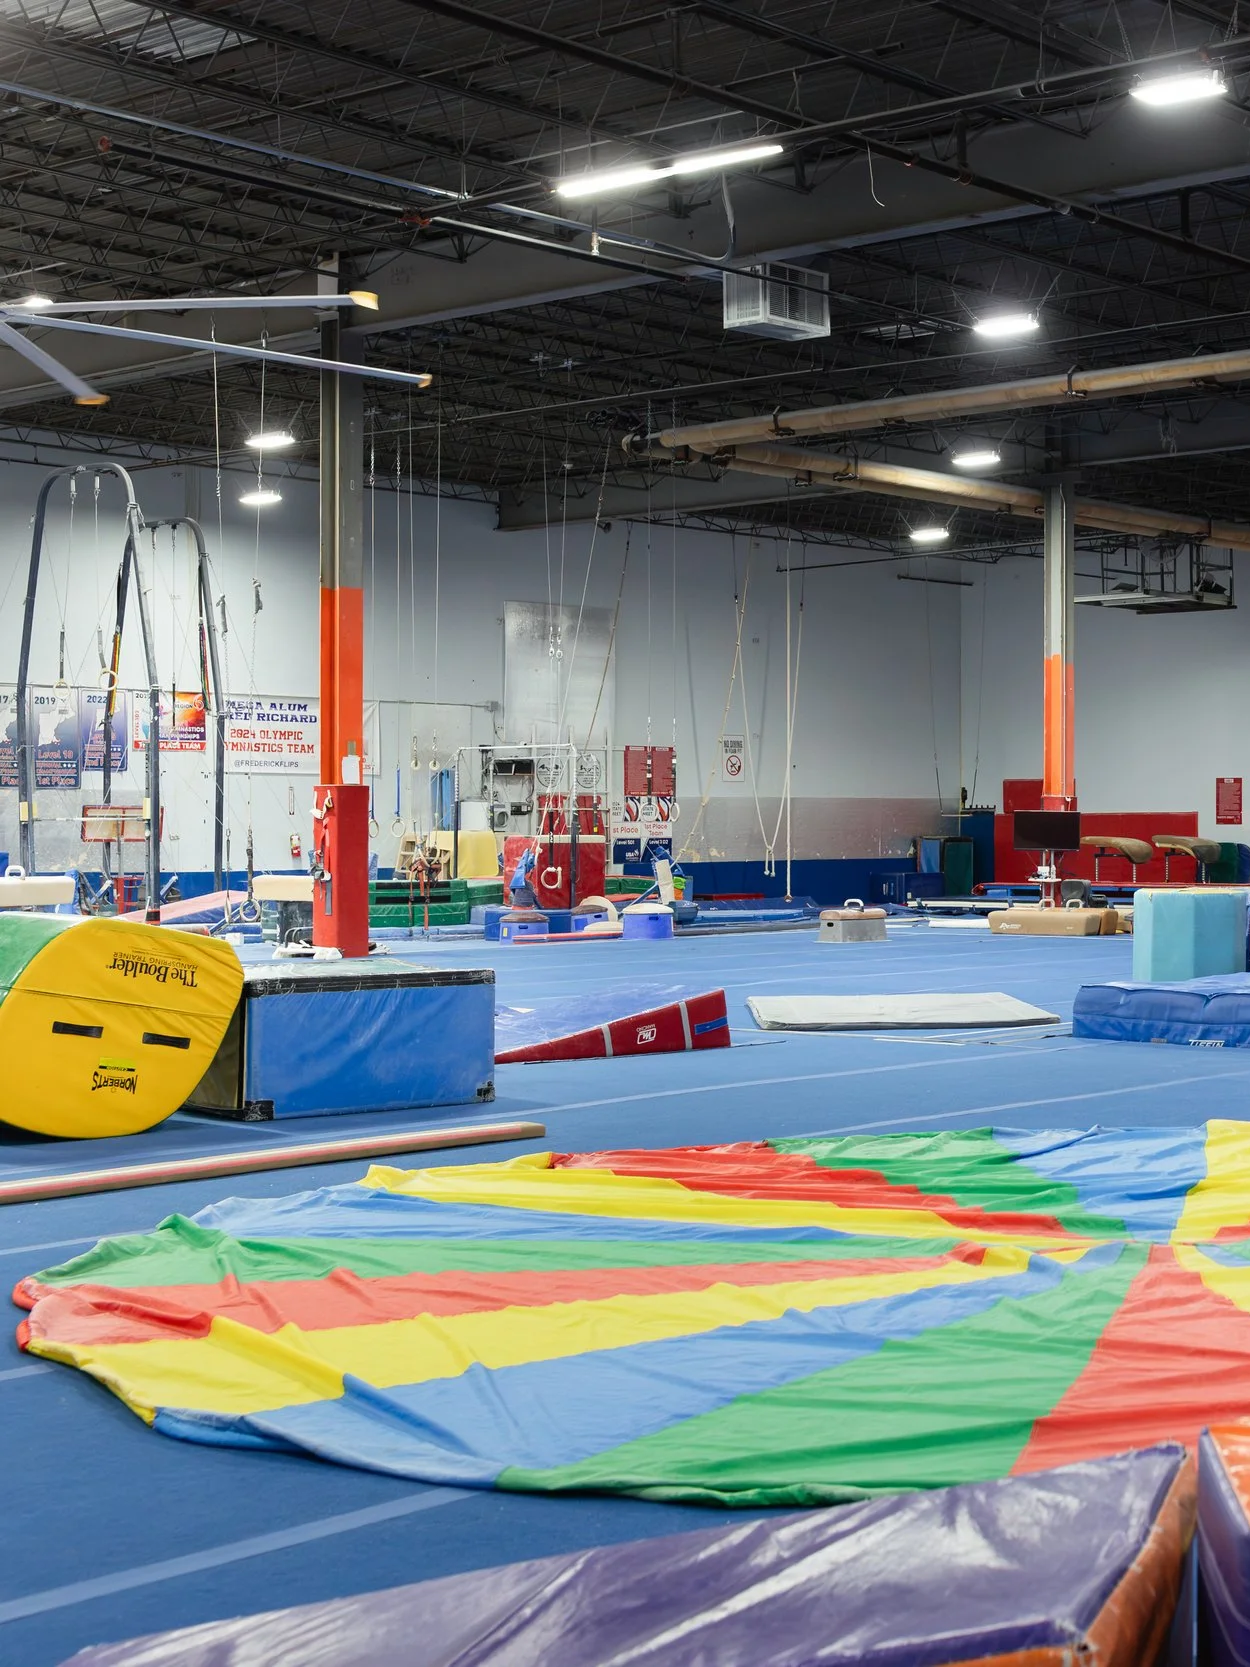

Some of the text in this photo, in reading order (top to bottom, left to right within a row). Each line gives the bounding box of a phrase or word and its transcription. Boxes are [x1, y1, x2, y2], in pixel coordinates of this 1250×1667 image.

[34, 696, 56, 705] 2019
[269, 702, 308, 711] ALUM
[256, 712, 318, 724] RICHARD
[230, 728, 303, 741] 2024 OLYMPIC
[224, 741, 315, 754] YMNASTICS TEAM
[233, 759, 299, 768] @FREDERICKFLIPS
[620, 826, 639, 834] Place
[112, 951, 147, 963] TRAINER
[149, 957, 199, 971] HANDSPRING
[109, 958, 199, 988] The Boulder
[91, 1070, 139, 1094] NORBERTS
